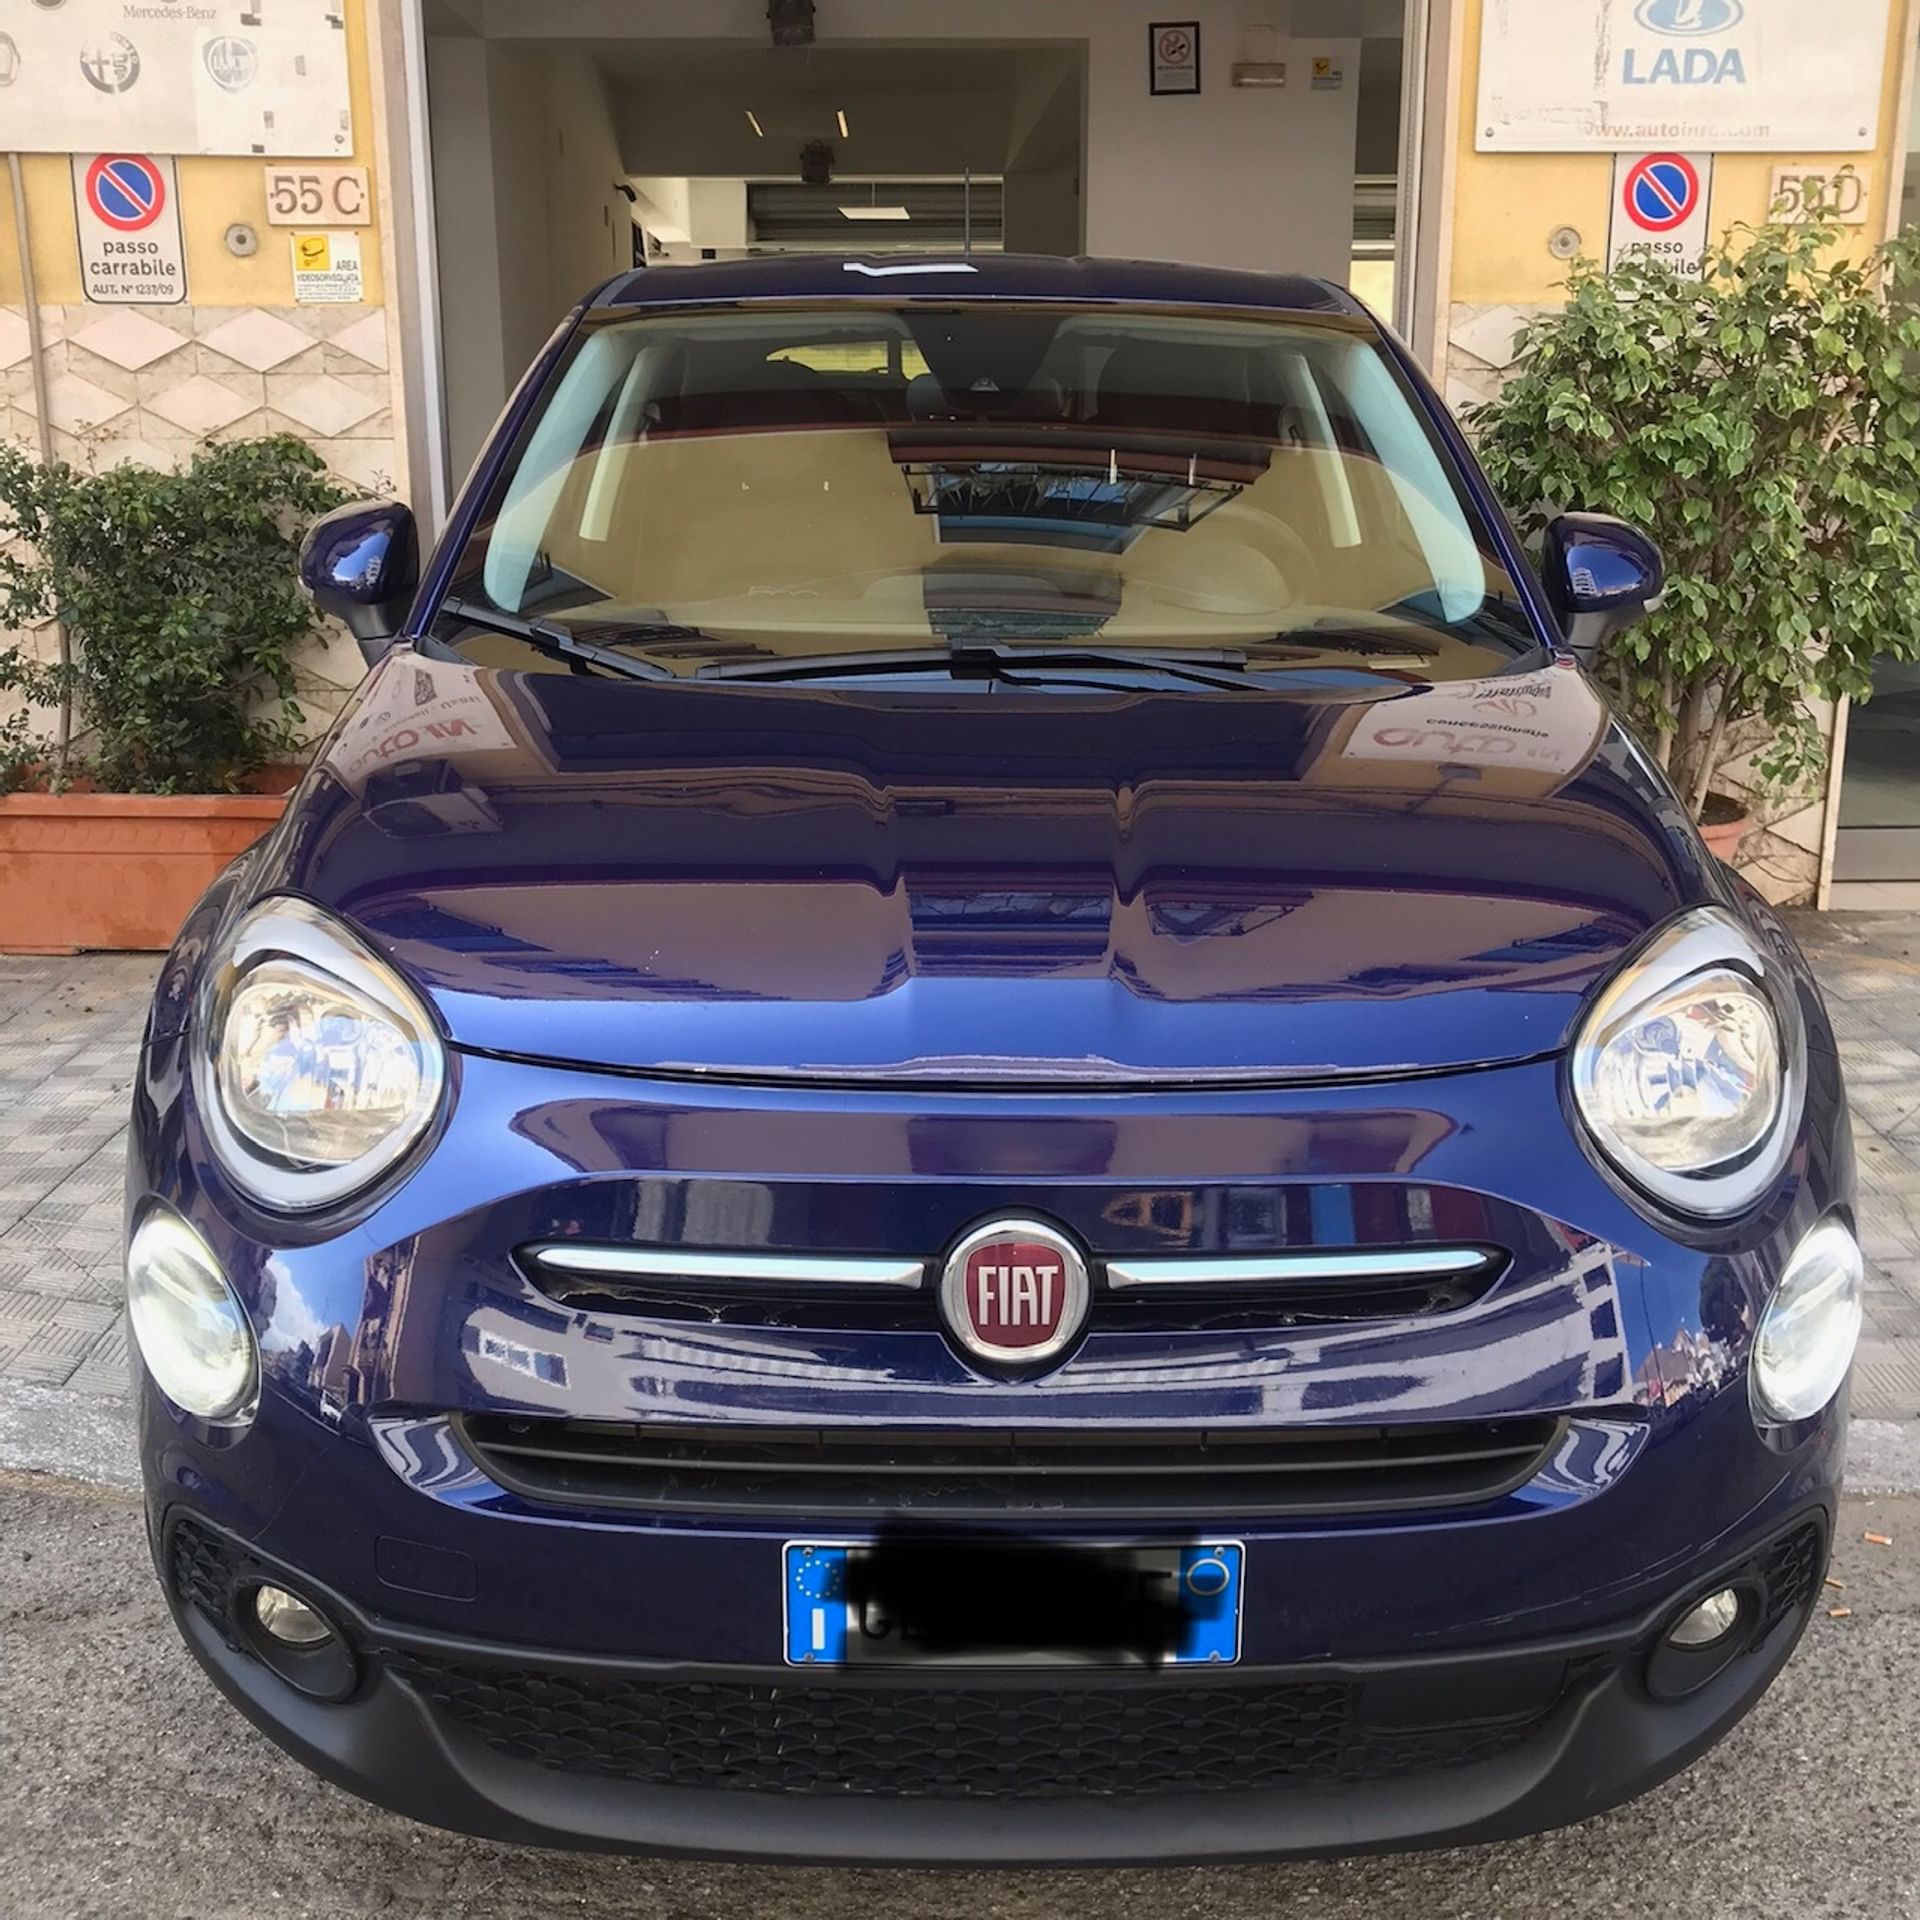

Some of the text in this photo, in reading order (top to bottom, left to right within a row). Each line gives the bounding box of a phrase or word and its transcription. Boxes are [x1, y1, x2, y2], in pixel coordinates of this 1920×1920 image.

[123, 5, 217, 20] Mercedes-Benz
[1621, 48, 1746, 85] LADA
[272, 175, 361, 215] 55 C
[103, 241, 159, 256] passo
[90, 259, 176, 276] carrabile
[336, 260, 358, 271] AREA
[92, 284, 119, 294] AUT.
[978, 1265, 1059, 1326] FIAT
